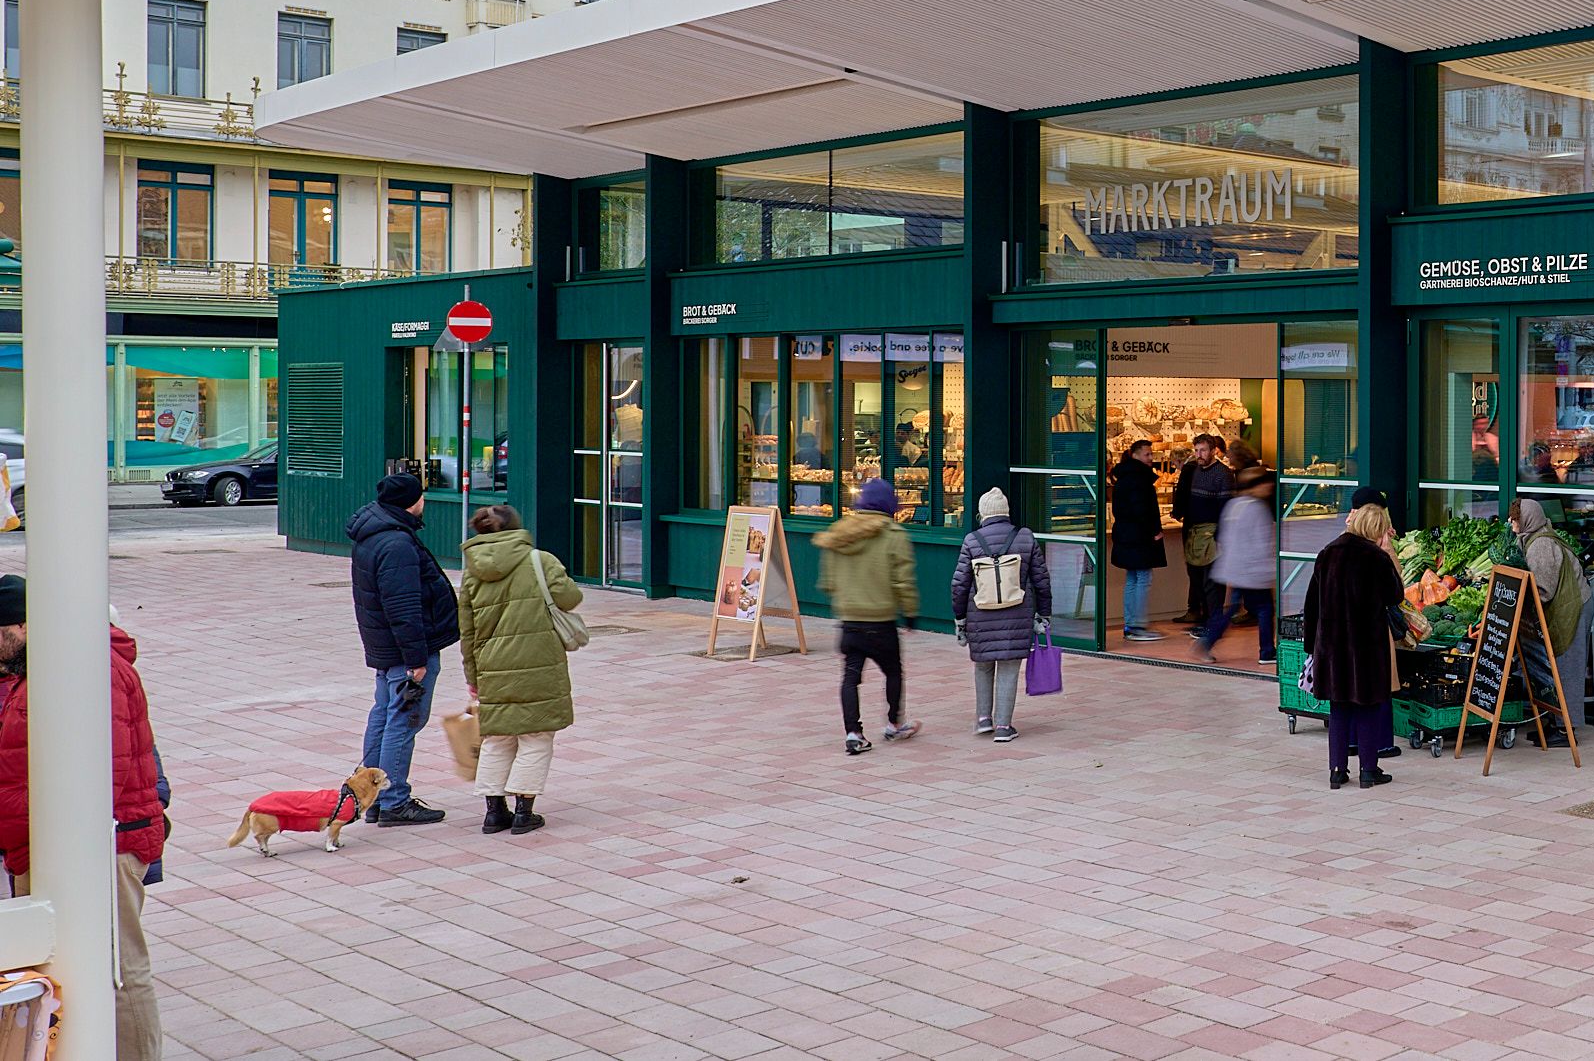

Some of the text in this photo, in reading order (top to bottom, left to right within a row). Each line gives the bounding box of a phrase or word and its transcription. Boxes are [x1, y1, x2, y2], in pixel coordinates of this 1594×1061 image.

[1084, 167, 1293, 236] MARKTRAUM
[1419, 253, 1589, 278] GEMÜSE, OBST & PILZE
[1419, 273, 1571, 290] GÄRTNEREI BIOSCHANZE/HUT & STIEL
[682, 303, 737, 317] BROT & GEBÄCK
[1074, 340, 1170, 354] BRO & GEBÄCK
[1111, 354, 1138, 362] SORGER
